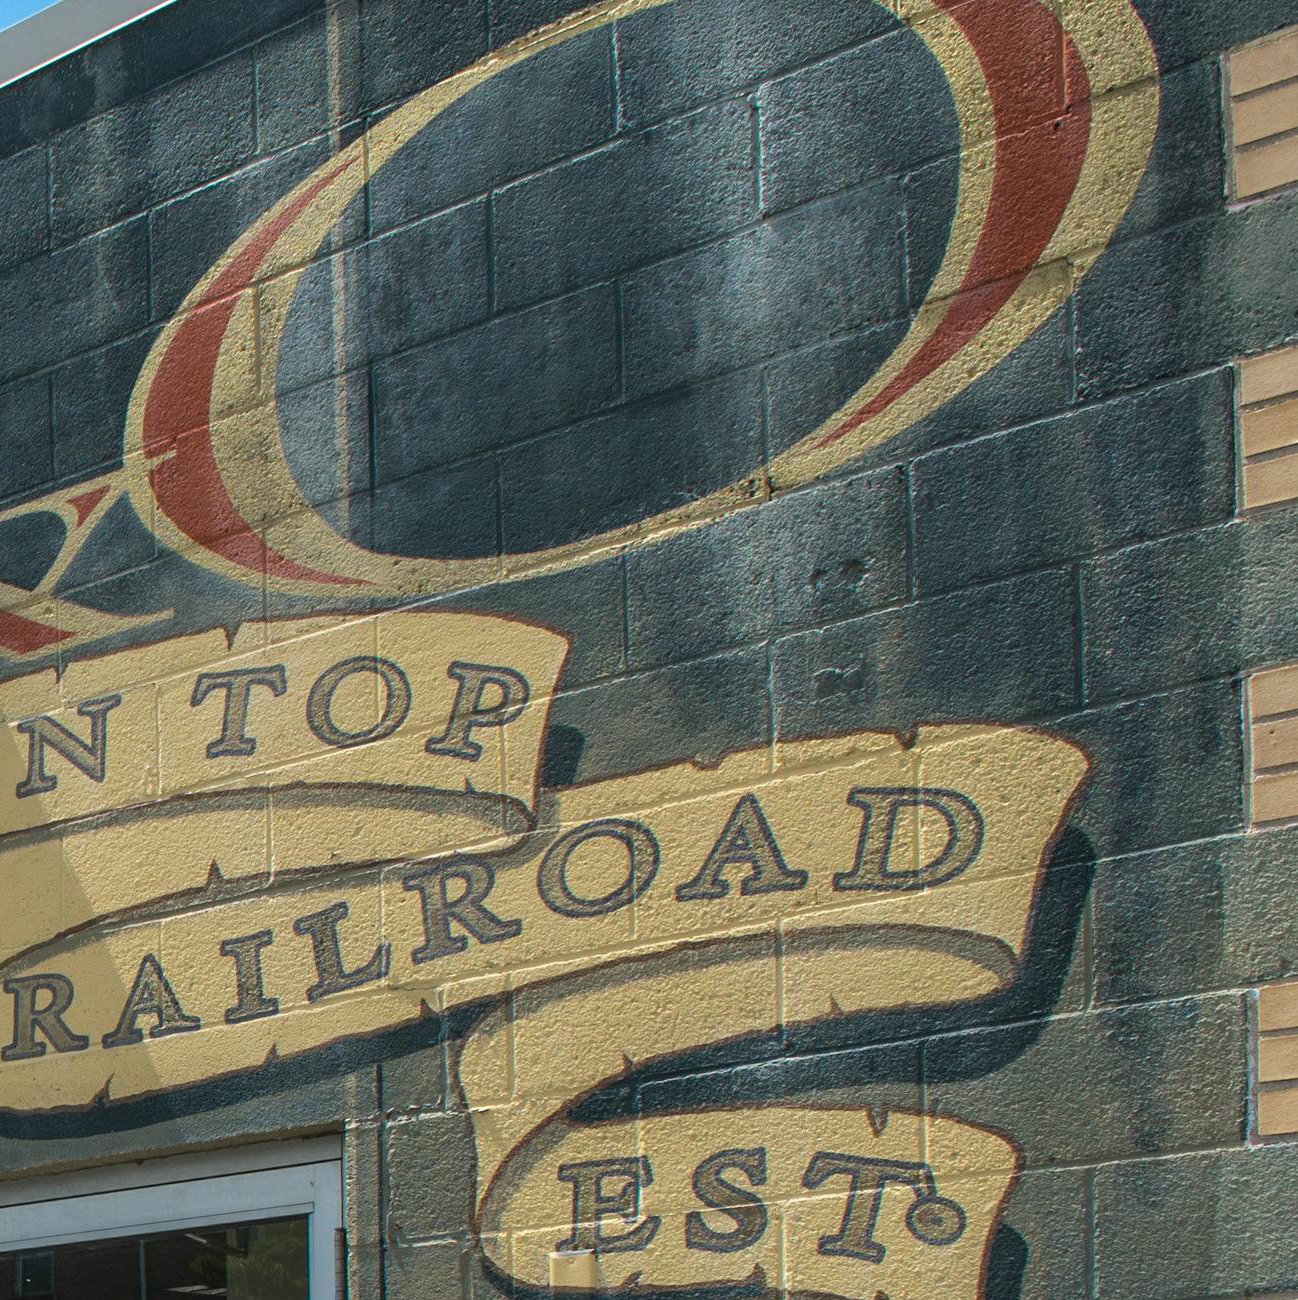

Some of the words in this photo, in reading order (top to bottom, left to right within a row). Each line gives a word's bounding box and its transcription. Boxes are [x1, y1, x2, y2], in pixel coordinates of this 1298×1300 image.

[189, 655, 531, 762] TOP
[3, 785, 985, 1061] RAILROAD
[556, 1146, 967, 1264] EST.
